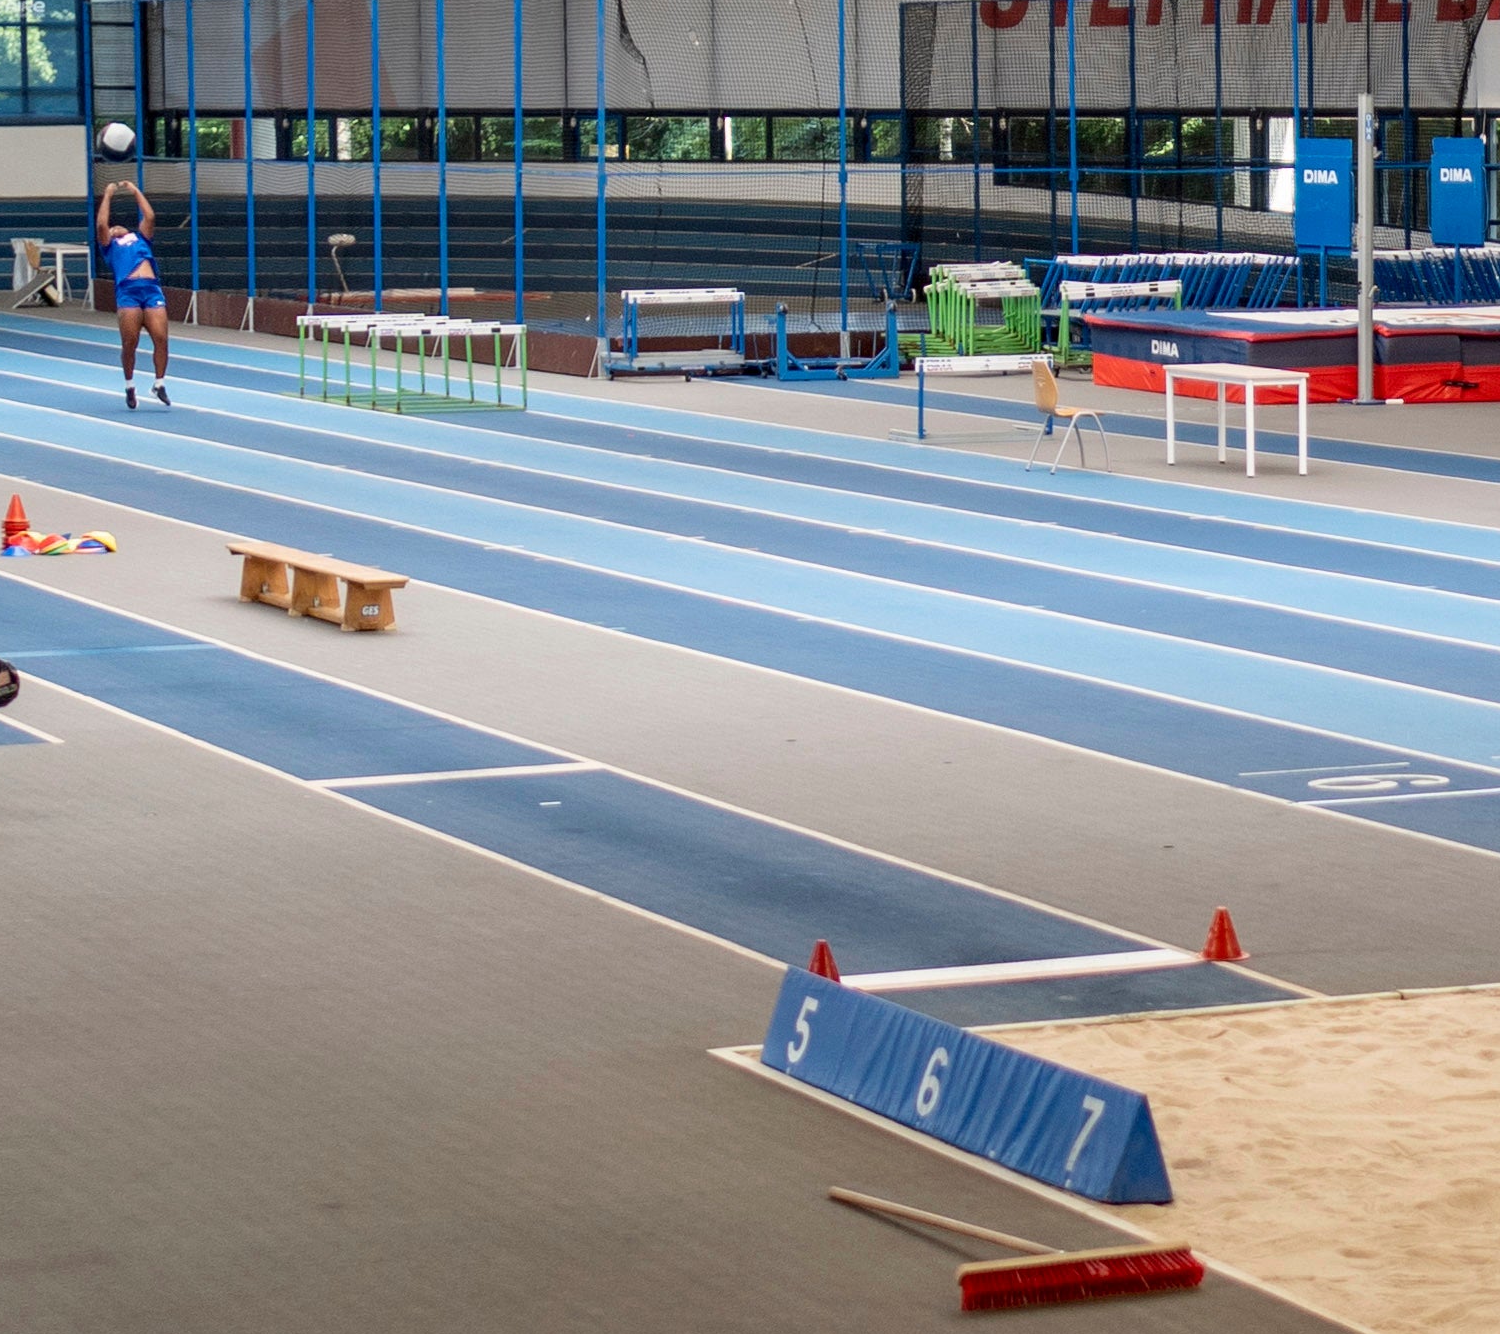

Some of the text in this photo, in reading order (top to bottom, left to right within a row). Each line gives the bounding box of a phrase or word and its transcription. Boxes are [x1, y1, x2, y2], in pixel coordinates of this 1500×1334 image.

[1303, 169, 1338, 184] DIMA
[1440, 168, 1472, 182] DIMA
[1151, 339, 1179, 358] DIMA
[1307, 773, 1450, 792] 6
[787, 995, 819, 1064] 5
[915, 1046, 948, 1117] 6
[1065, 1095, 1106, 1171] 7
